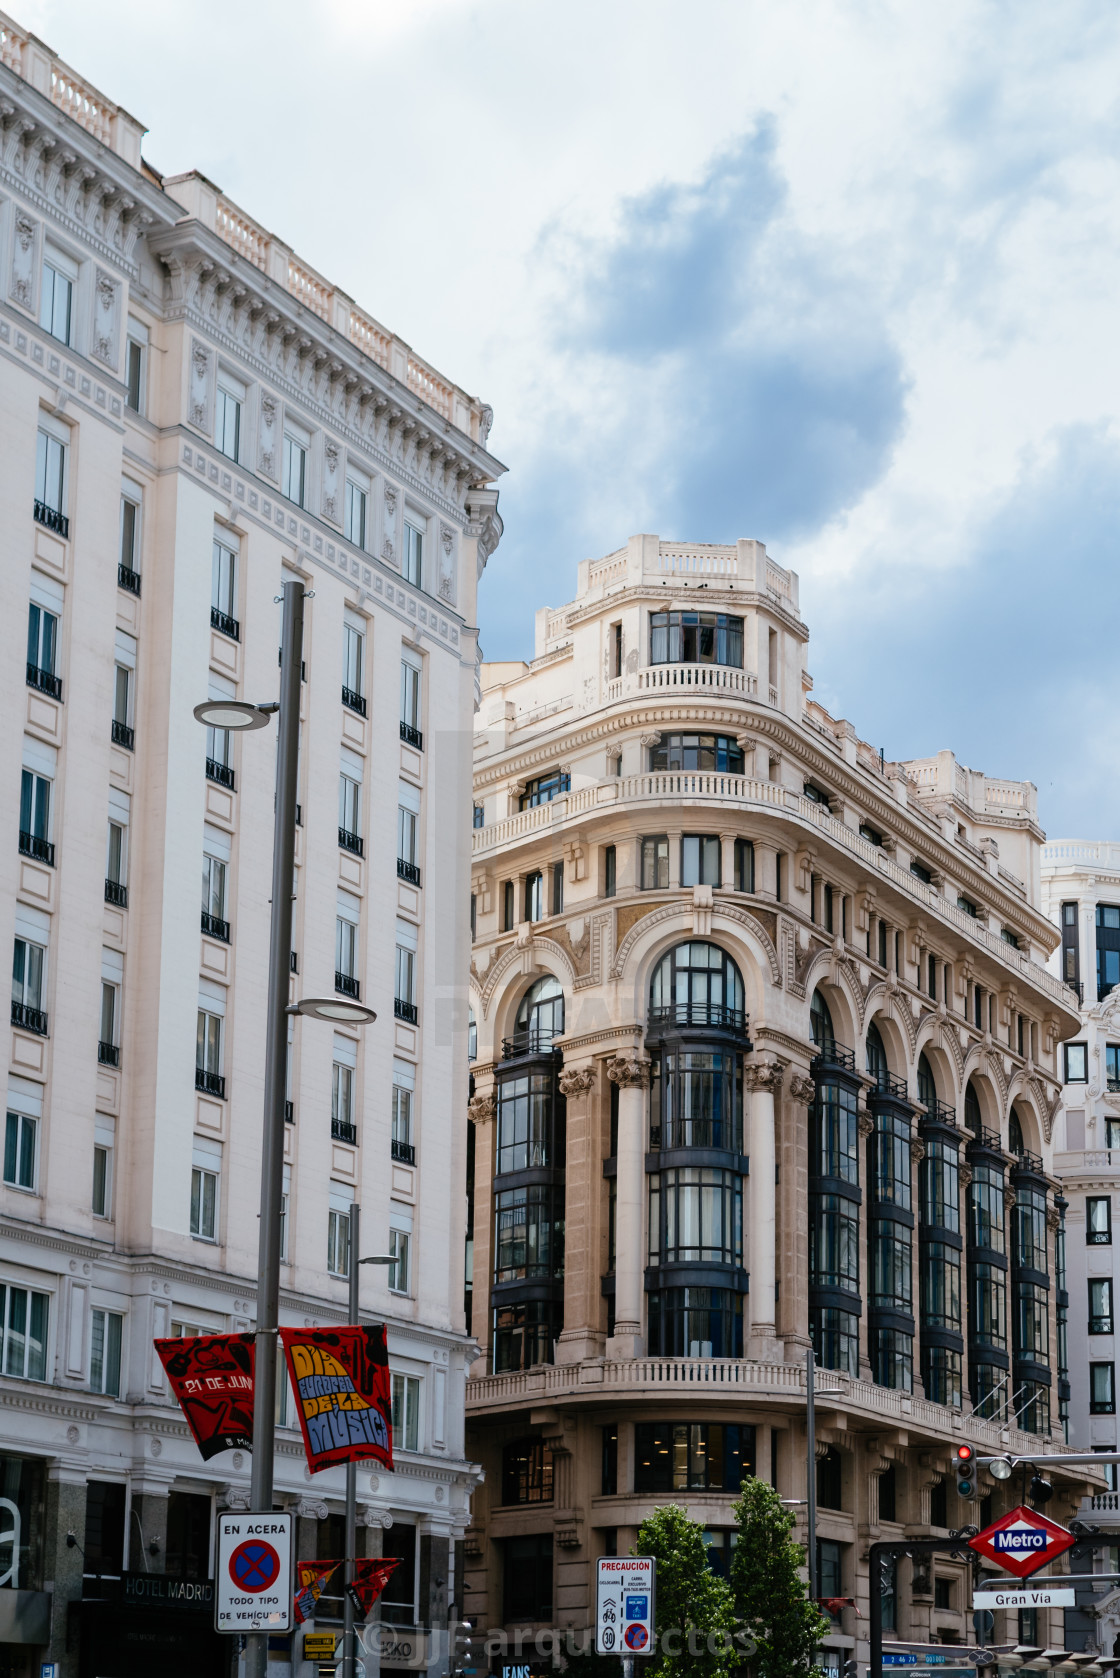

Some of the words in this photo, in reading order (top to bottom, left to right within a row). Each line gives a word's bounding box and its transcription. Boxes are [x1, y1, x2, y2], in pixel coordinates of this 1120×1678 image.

[185, 1380, 202, 1393] 21
[206, 1377, 225, 1389] DE
[224, 1526, 240, 1535] EN
[247, 1525, 286, 1534] ACERA
[999, 1533, 1043, 1548] Metro
[601, 1561, 650, 1571] PRECAUCIÓN
[126, 1578, 165, 1597] HOTEL
[168, 1582, 213, 1601] MADRID
[259, 1597, 279, 1605] TIPO
[995, 1595, 1026, 1605] Gran
[220, 1612, 231, 1620] DE
[236, 1611, 287, 1620] VEHÍCUS
[605, 1633, 613, 1644] 30
